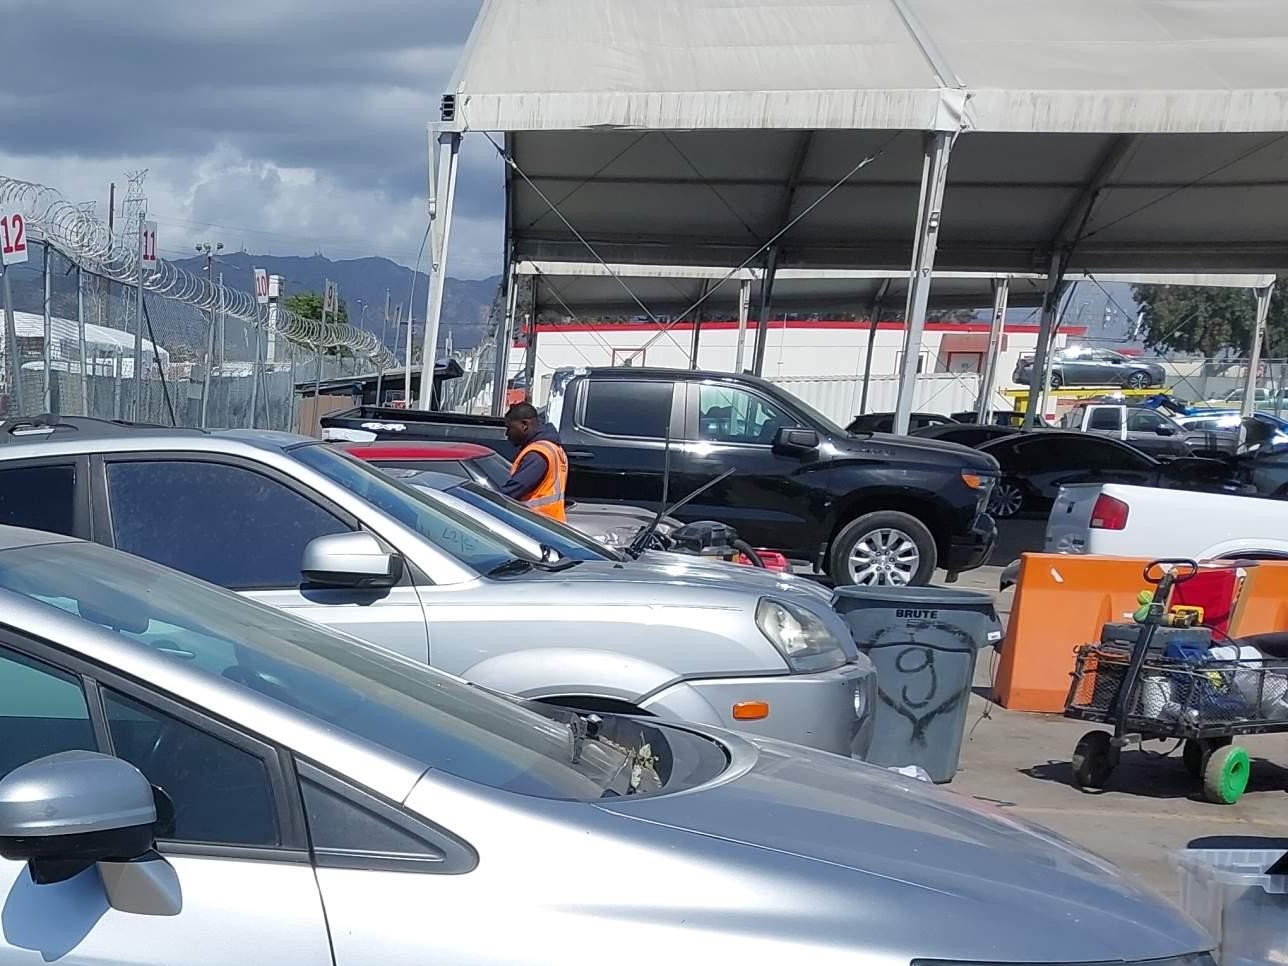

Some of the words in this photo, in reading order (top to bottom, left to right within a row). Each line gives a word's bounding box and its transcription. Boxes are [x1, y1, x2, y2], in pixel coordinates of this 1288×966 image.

[0, 214, 26, 254] 12
[143, 230, 156, 261] 11
[256, 275, 267, 297] 10
[895, 609, 938, 619] BRUTE
